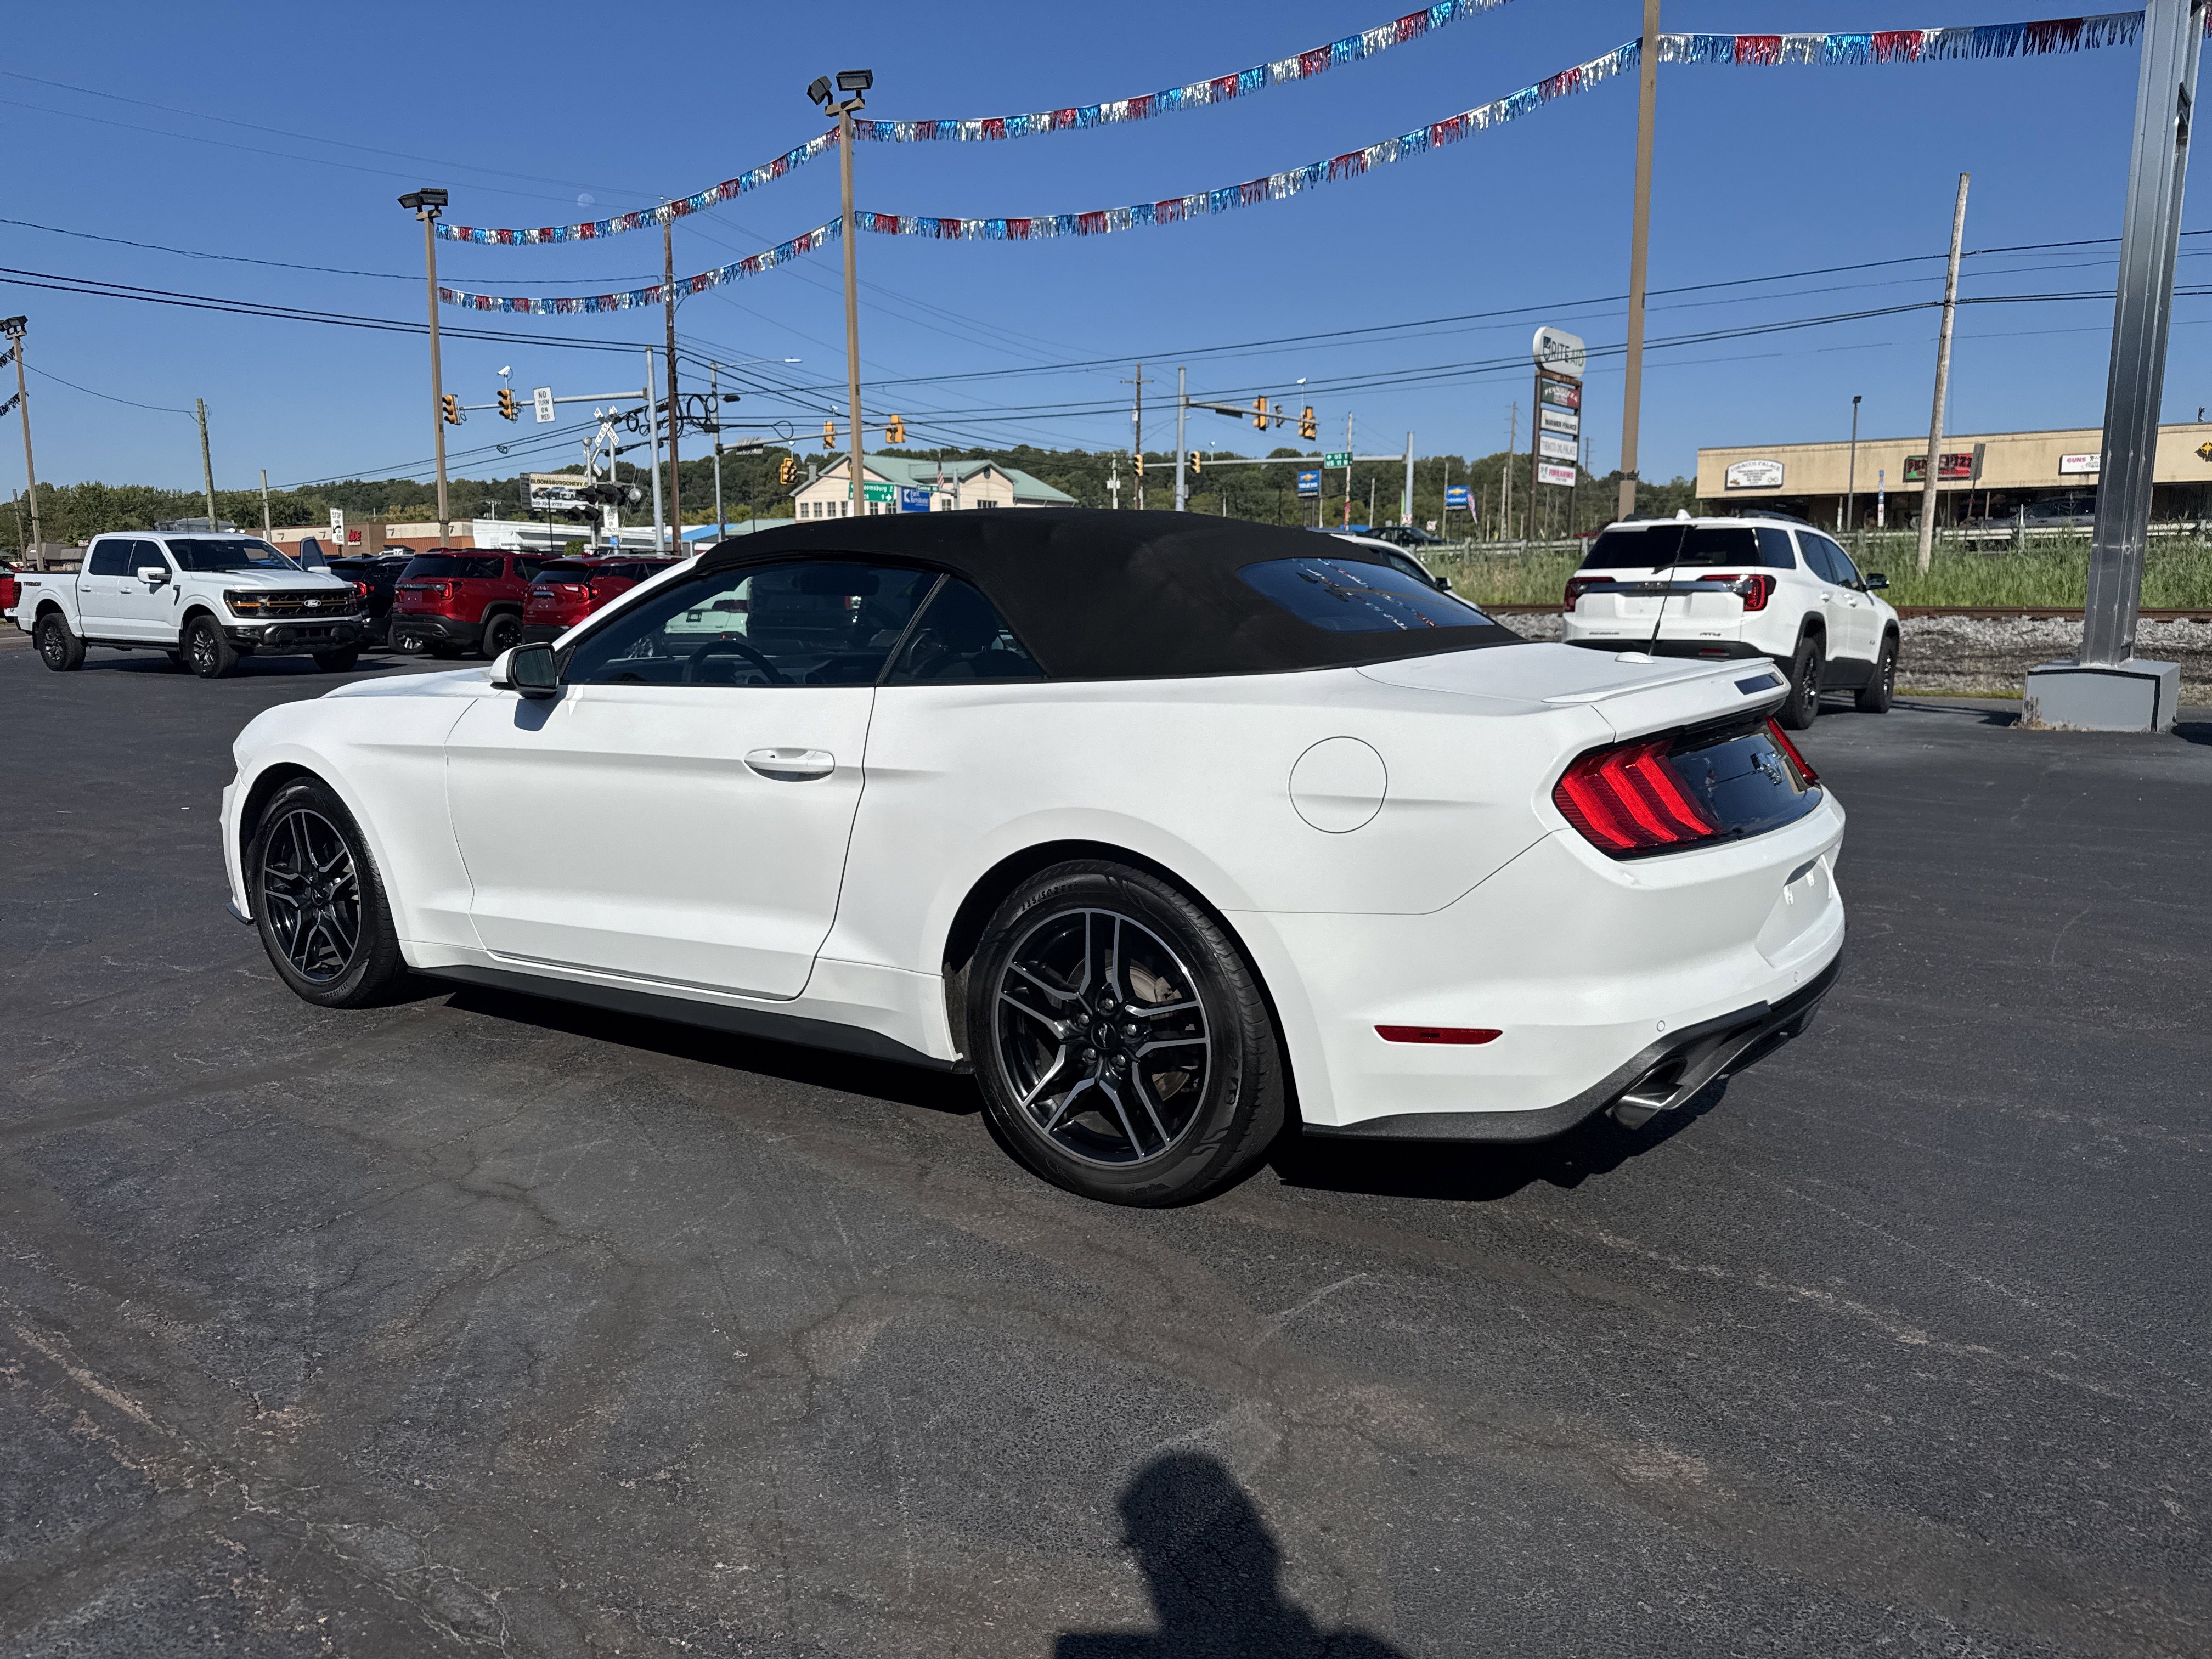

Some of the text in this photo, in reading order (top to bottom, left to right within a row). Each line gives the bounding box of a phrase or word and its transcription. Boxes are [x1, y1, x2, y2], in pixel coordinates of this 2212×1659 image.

[1551, 341, 1584, 367] RITE AID
[538, 391, 546, 399] NO
[608, 428, 618, 443] ROAD
[1731, 462, 1781, 472] TOBACCO PALACE
[1945, 456, 1972, 468] PIZZ
[531, 479, 588, 487] BLOOMSBURGCHEVY.C
[864, 485, 887, 493] oomsburg
[348, 529, 362, 542] ACE
